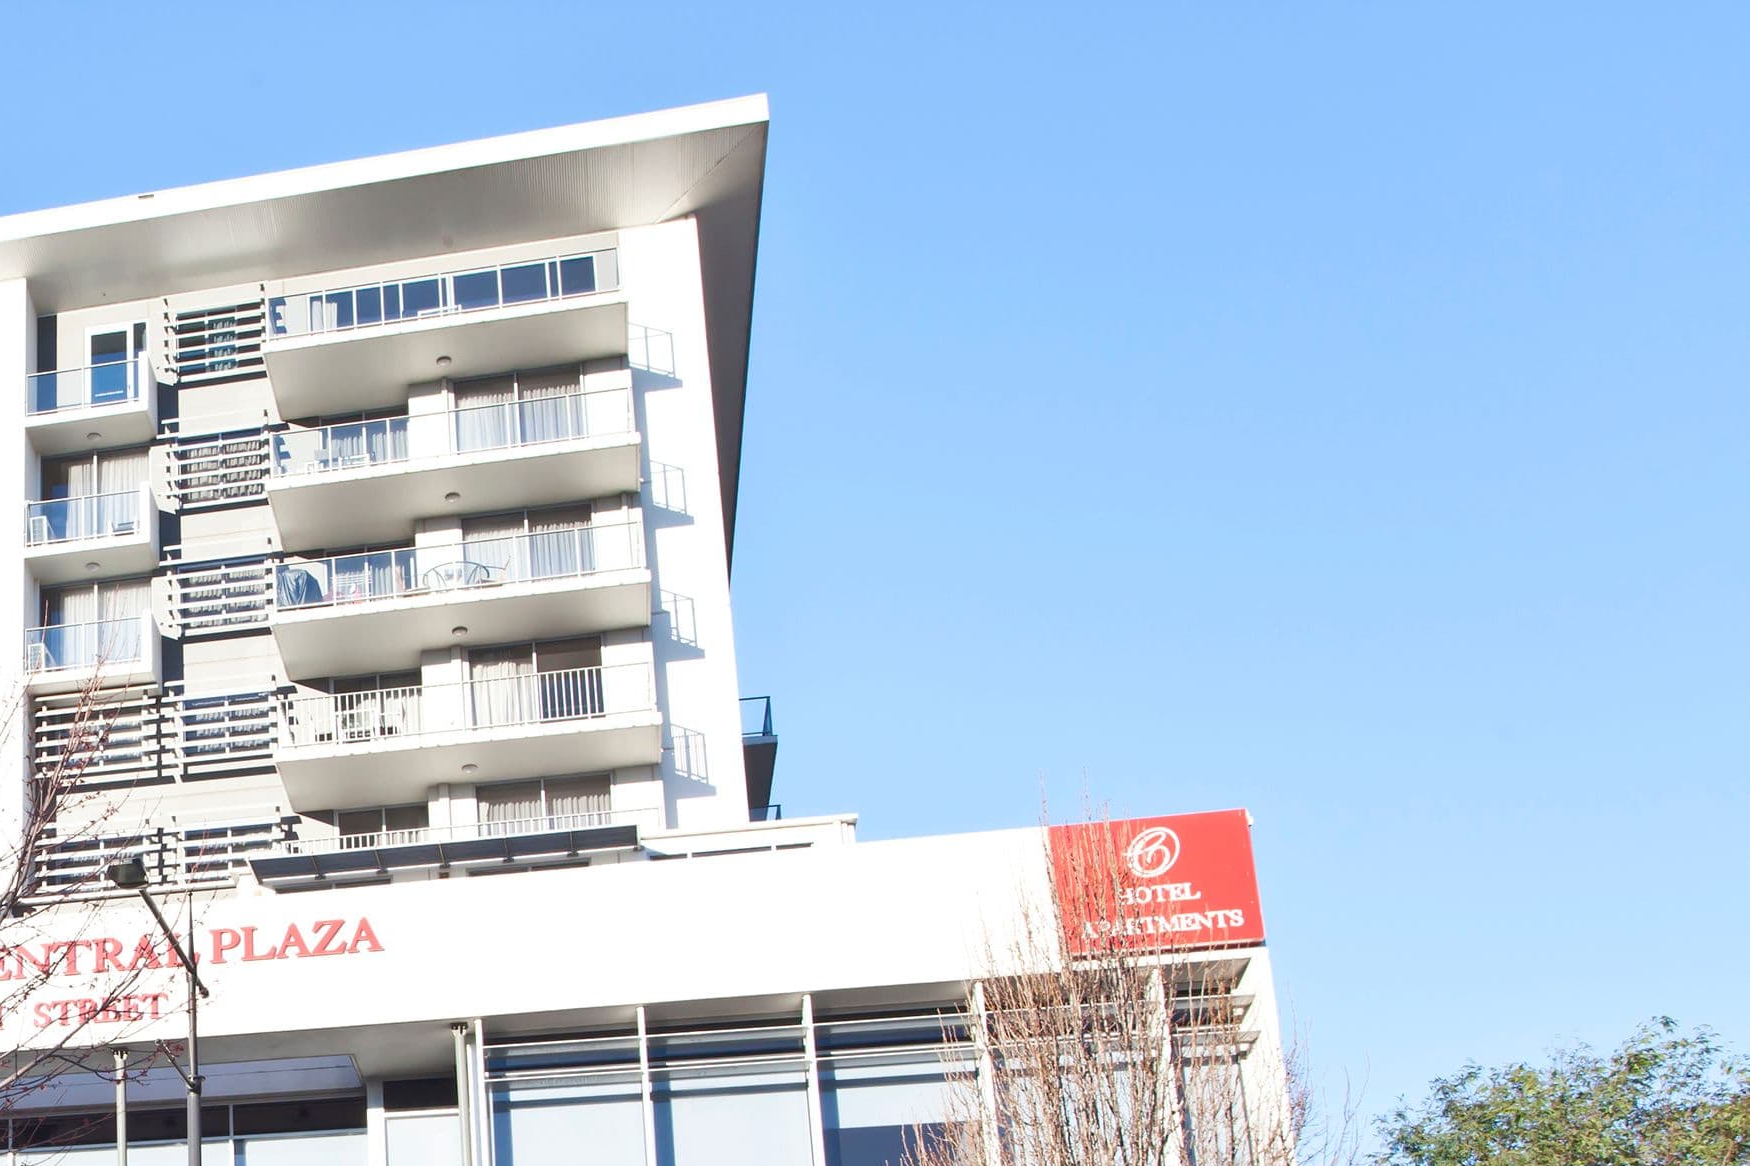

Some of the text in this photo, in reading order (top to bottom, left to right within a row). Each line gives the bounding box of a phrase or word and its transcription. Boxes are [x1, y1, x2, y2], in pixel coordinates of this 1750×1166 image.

[1119, 882, 1202, 906] HOTEL
[209, 917, 385, 965] PLAZA
[1081, 909, 1245, 940] APARTMENTS
[33, 992, 168, 1029] STREET
